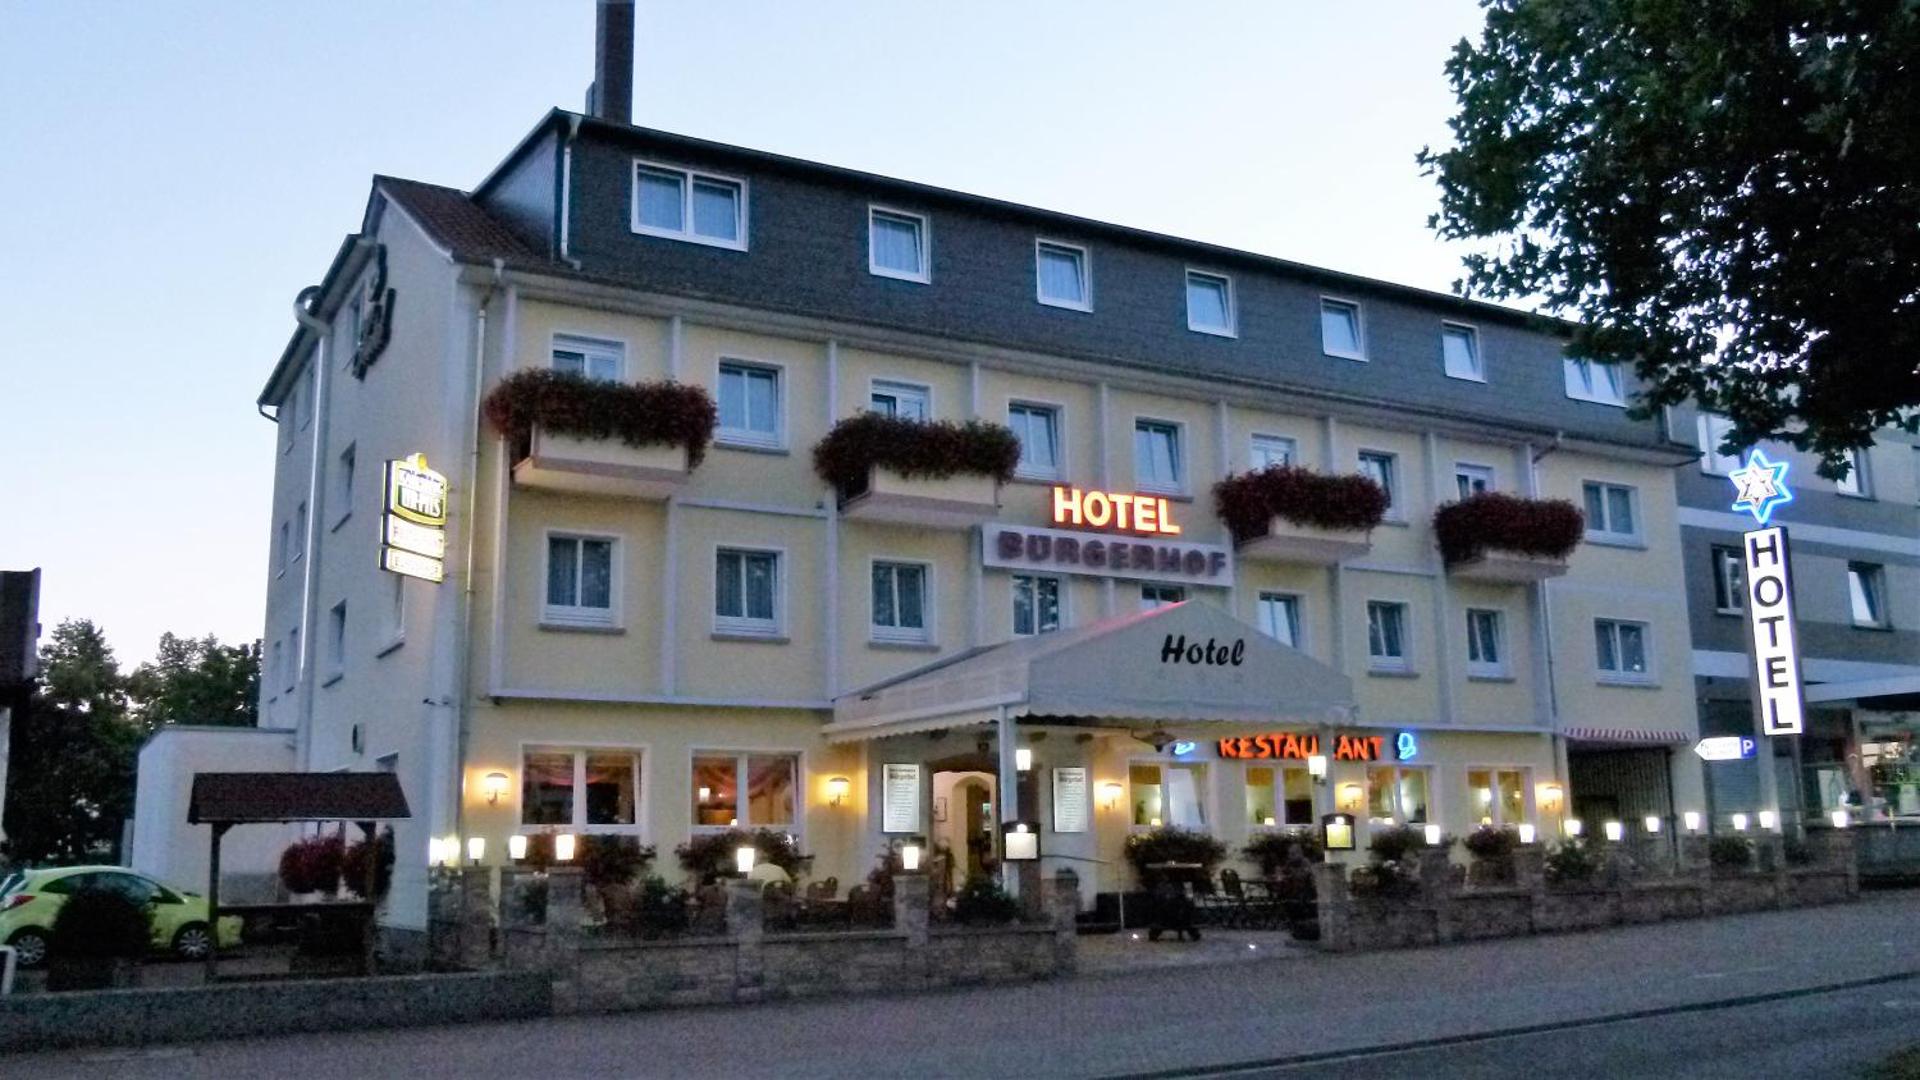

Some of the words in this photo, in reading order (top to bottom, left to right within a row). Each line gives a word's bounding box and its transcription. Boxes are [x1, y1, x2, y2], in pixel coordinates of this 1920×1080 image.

[1053, 486, 1181, 535] HOTEL
[1160, 634, 1245, 667] Hotel
[1749, 534, 1793, 730] HOTEL
[1219, 732, 1384, 761] RESTAUANT
